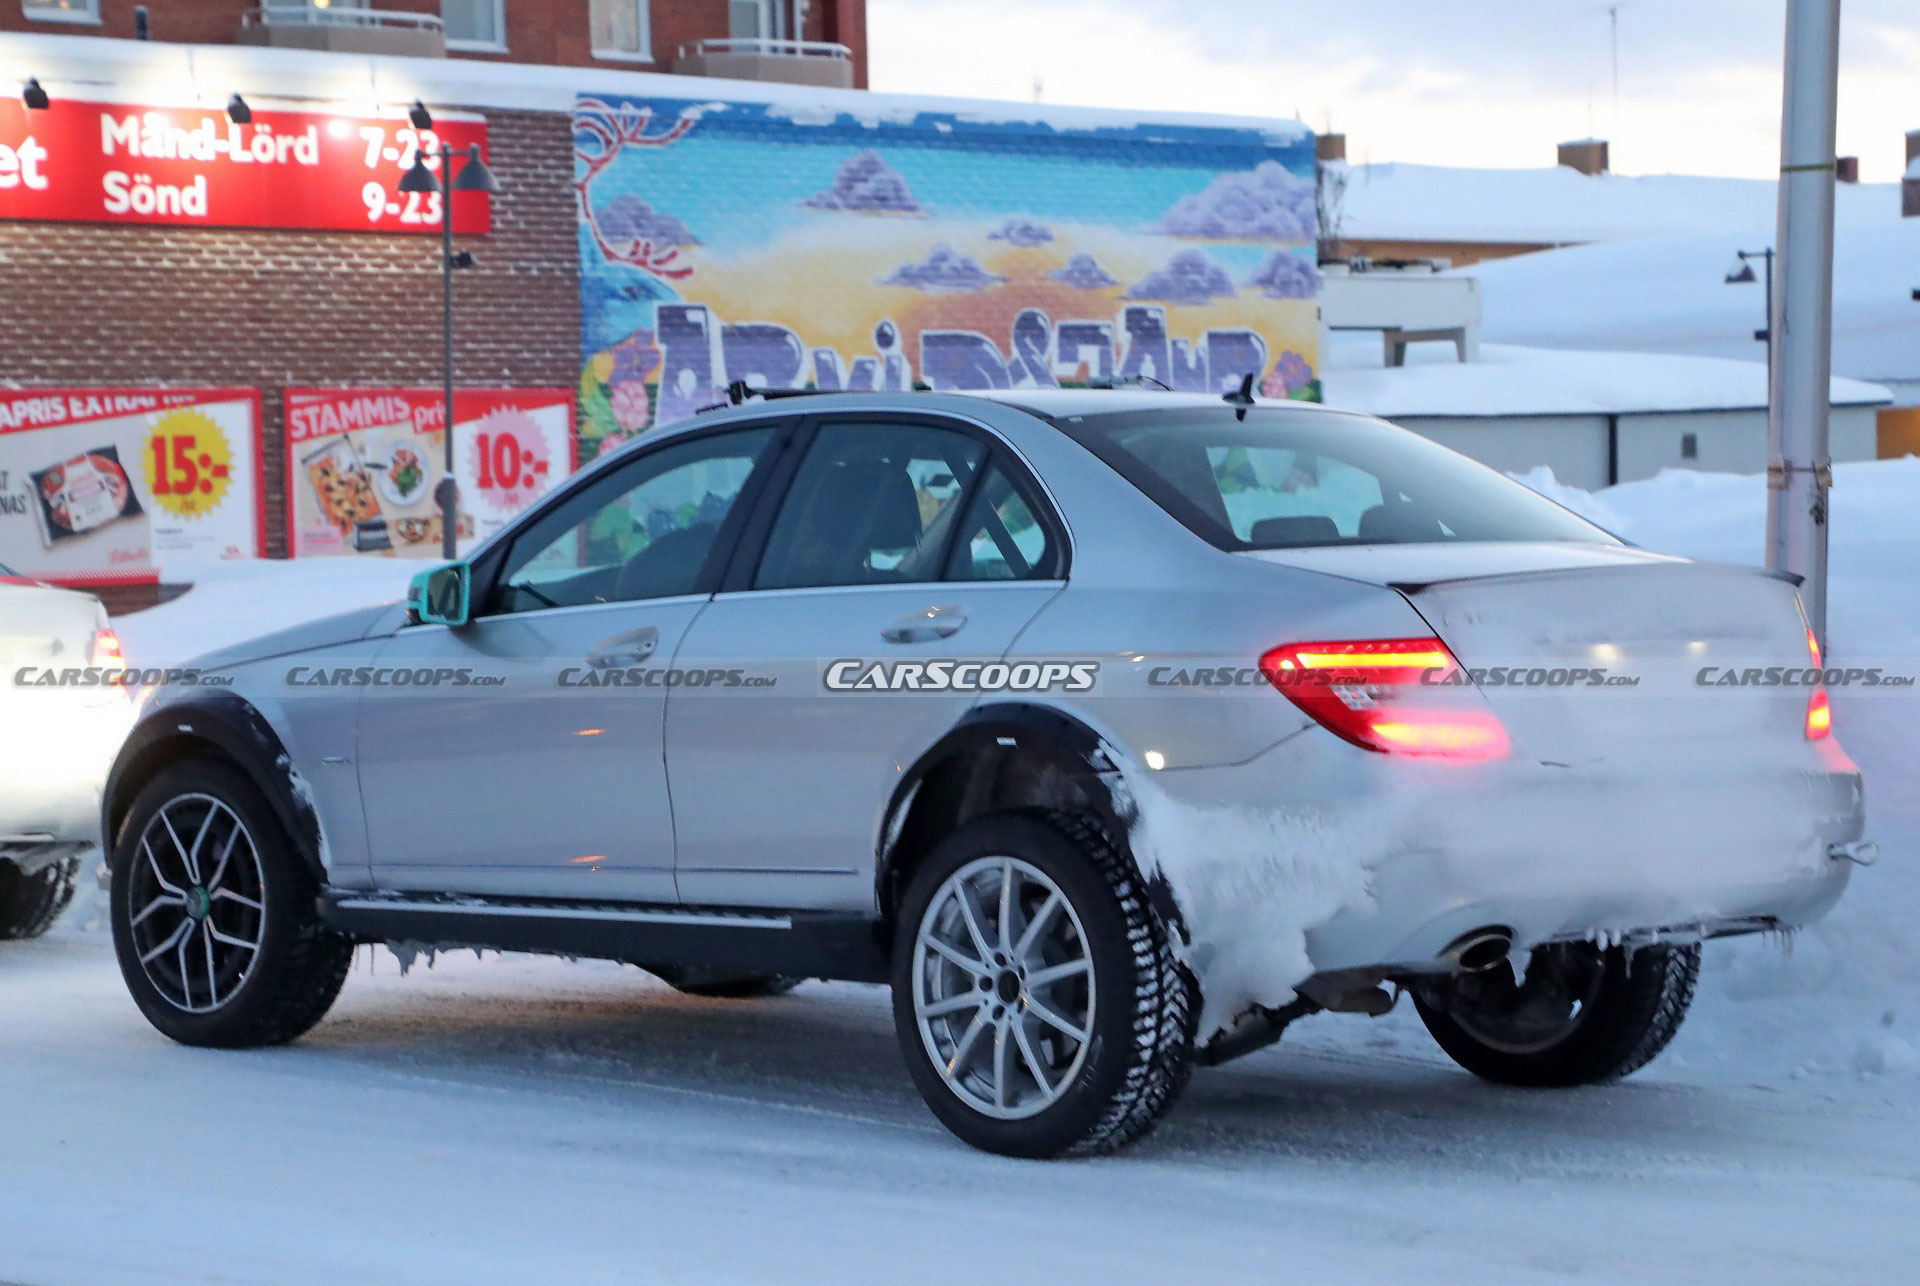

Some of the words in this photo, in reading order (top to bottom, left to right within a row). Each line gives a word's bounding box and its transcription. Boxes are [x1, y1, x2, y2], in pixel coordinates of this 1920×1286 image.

[101, 112, 318, 165] Månd-Lörd
[359, 126, 439, 170] 7-23
[103, 171, 208, 217] Sönd
[362, 181, 443, 224] 9-23
[290, 396, 411, 439] STAMMIS
[414, 399, 446, 433] pri
[152, 435, 229, 495] 15:-
